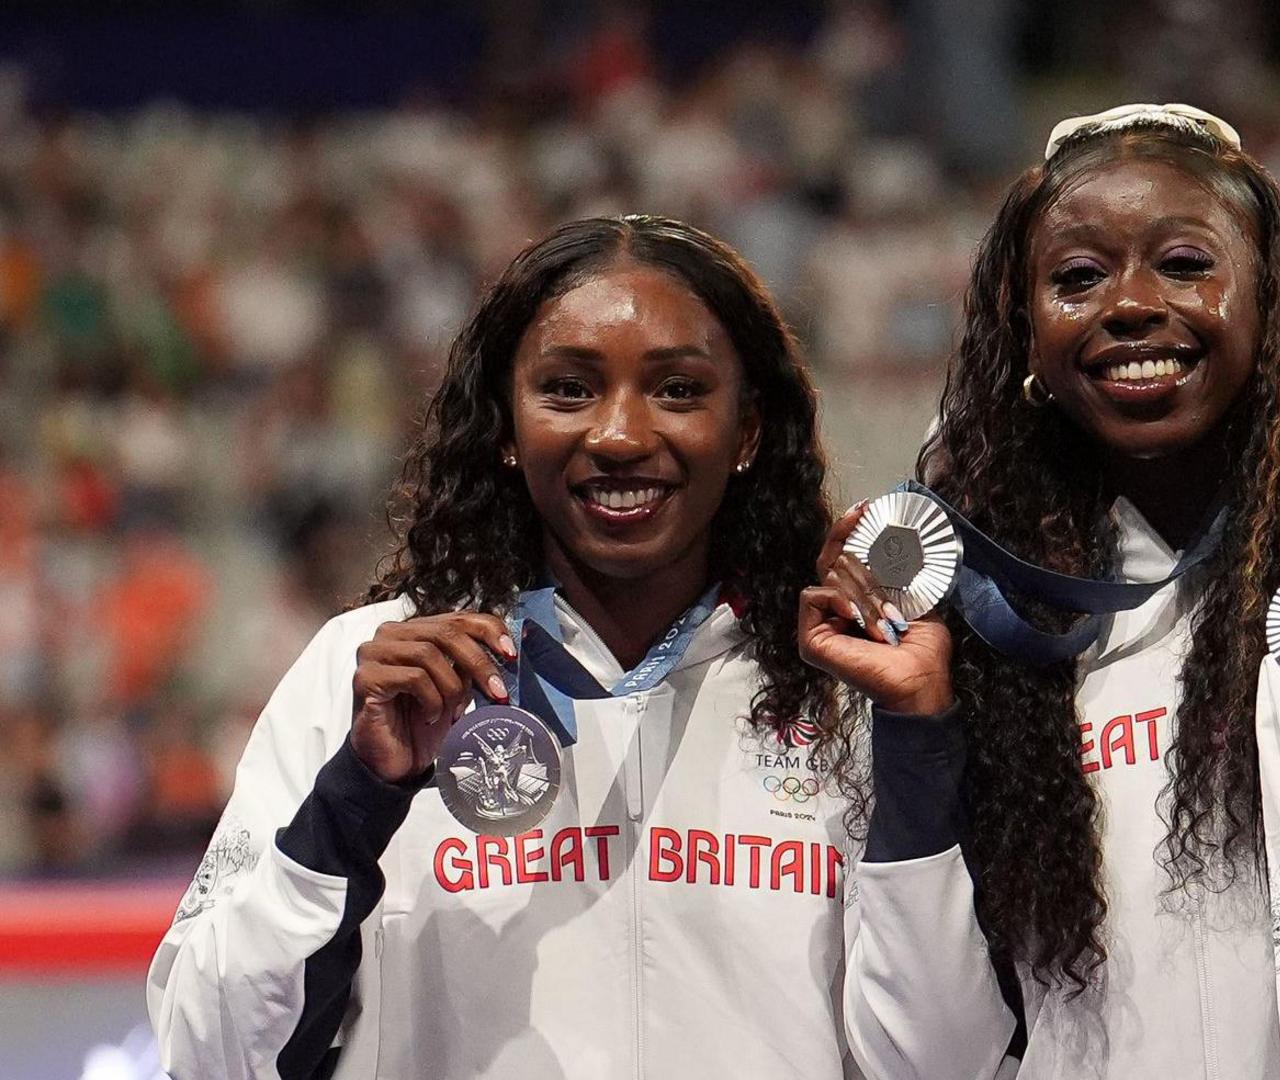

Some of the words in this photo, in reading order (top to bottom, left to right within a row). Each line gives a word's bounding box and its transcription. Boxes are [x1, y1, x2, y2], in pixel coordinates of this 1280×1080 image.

[755, 754, 800, 770] TEAM
[805, 757, 830, 772] GB
[433, 825, 620, 893] GREAT
